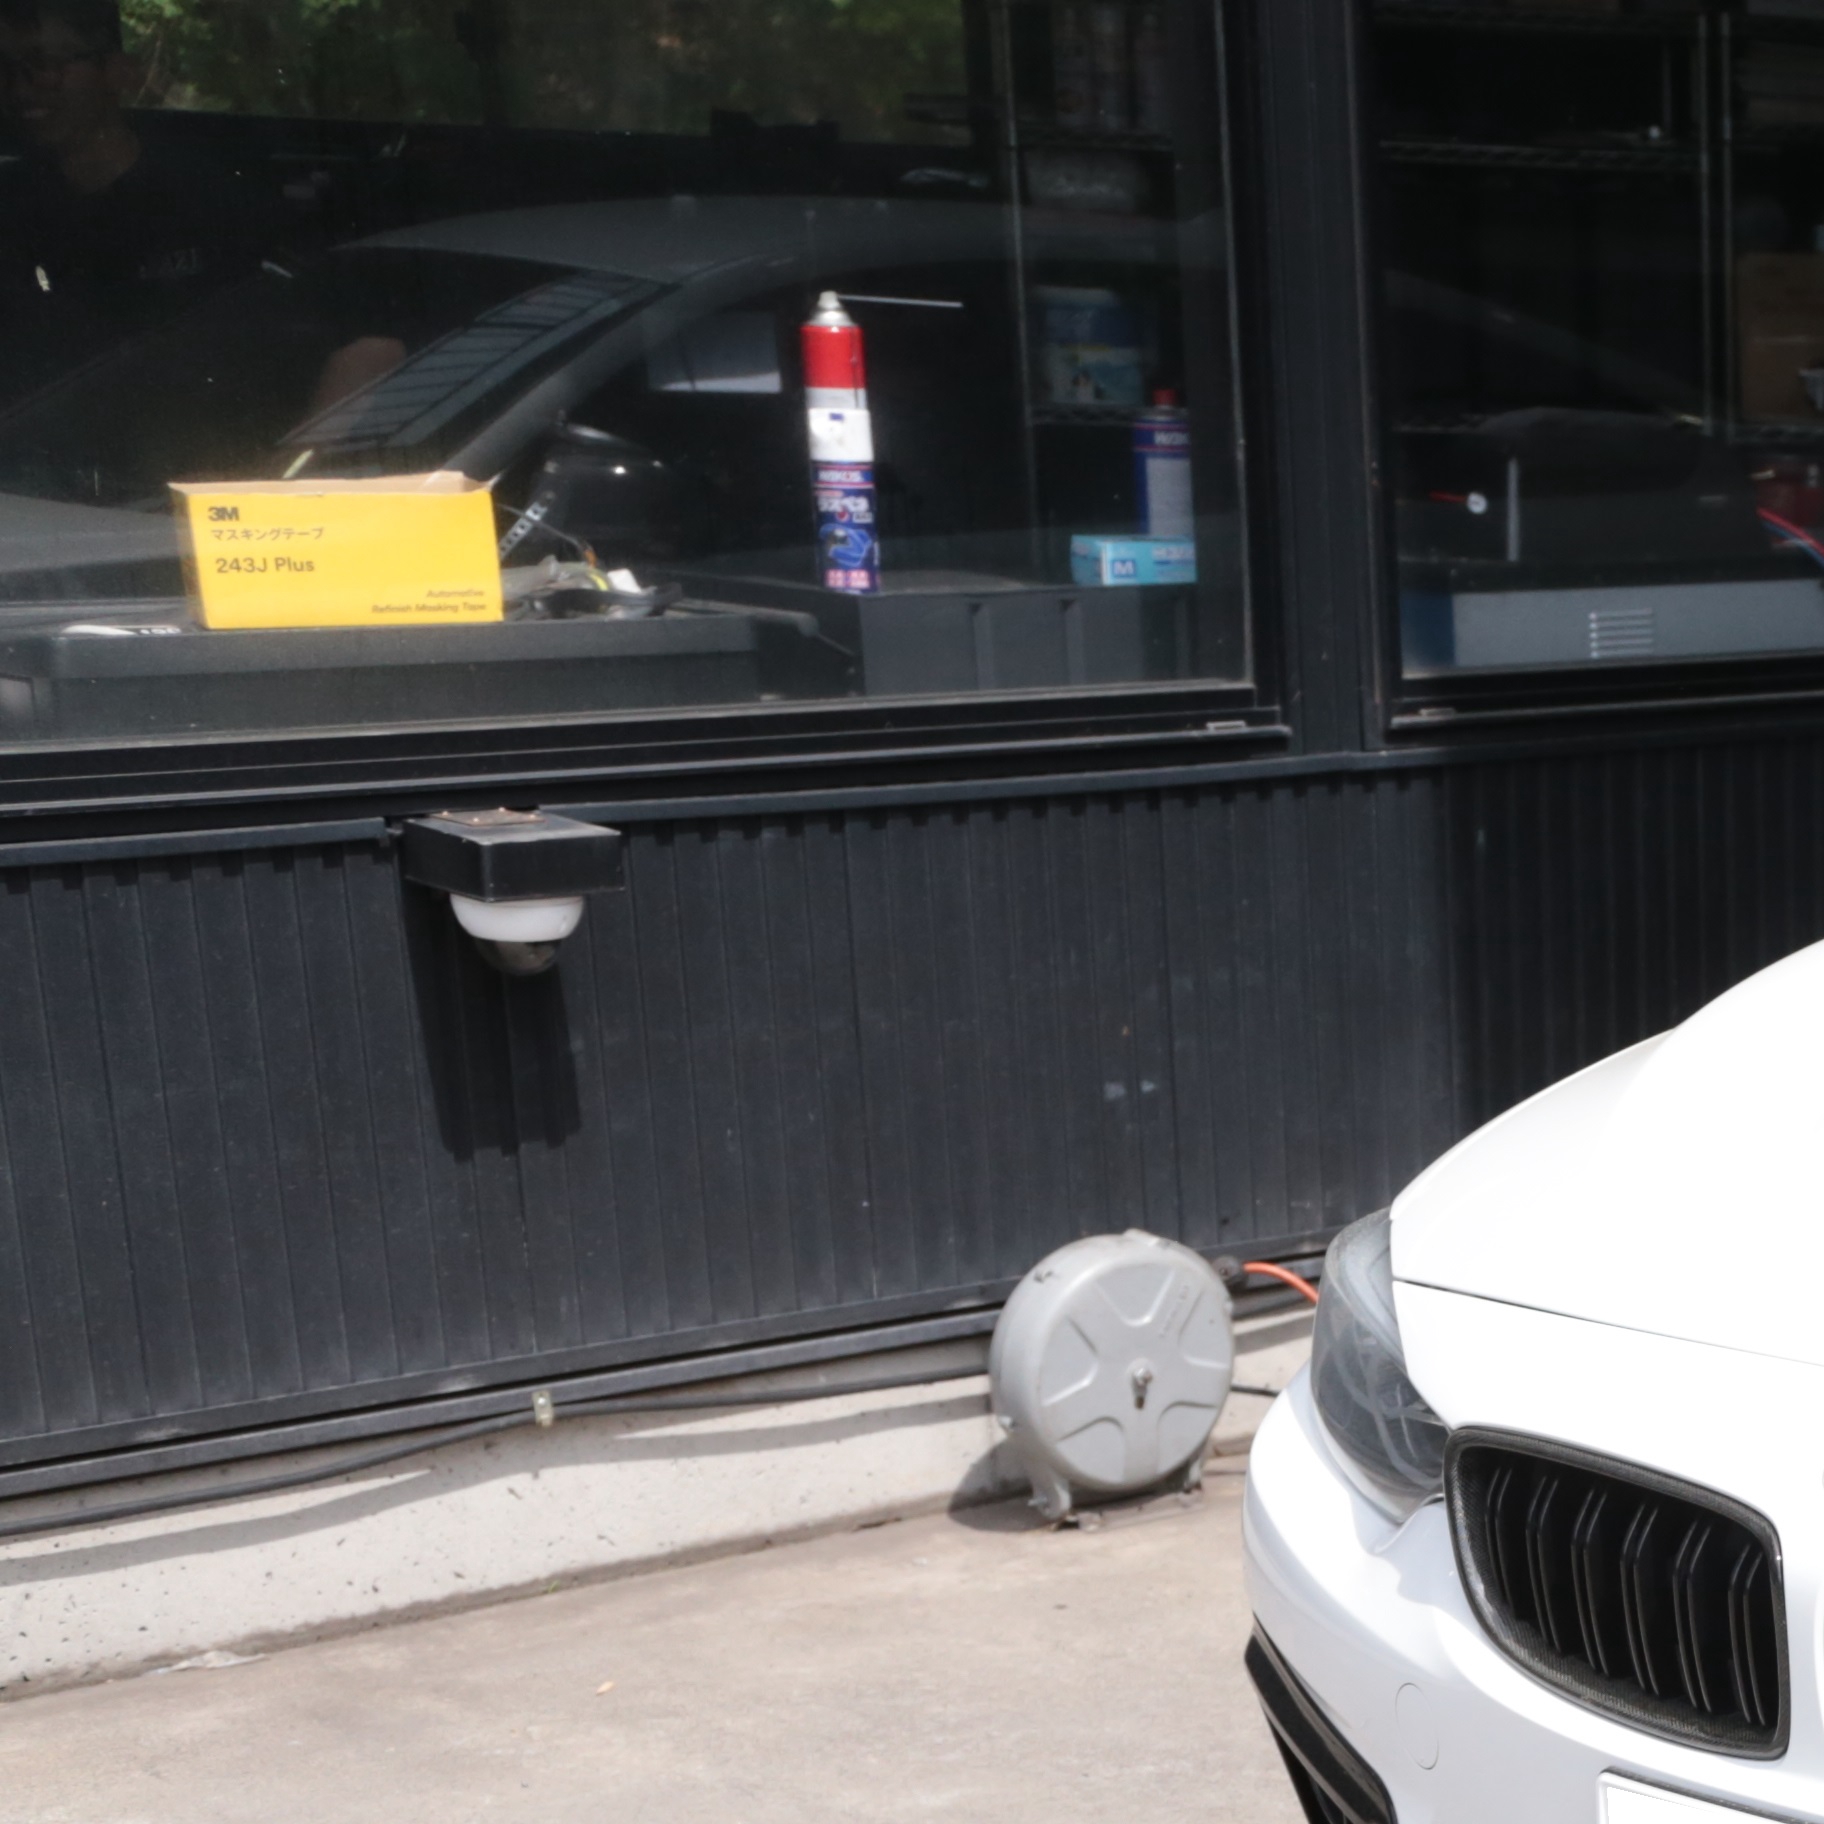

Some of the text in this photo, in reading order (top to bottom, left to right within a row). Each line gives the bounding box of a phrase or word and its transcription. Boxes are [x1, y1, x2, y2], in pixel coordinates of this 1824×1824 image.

[207, 506, 240, 522] 3M
[212, 527, 324, 541] マスキングテープ
[215, 556, 315, 573] 243J Plus
[414, 602, 459, 614] Masking
[462, 602, 486, 612] Tape
